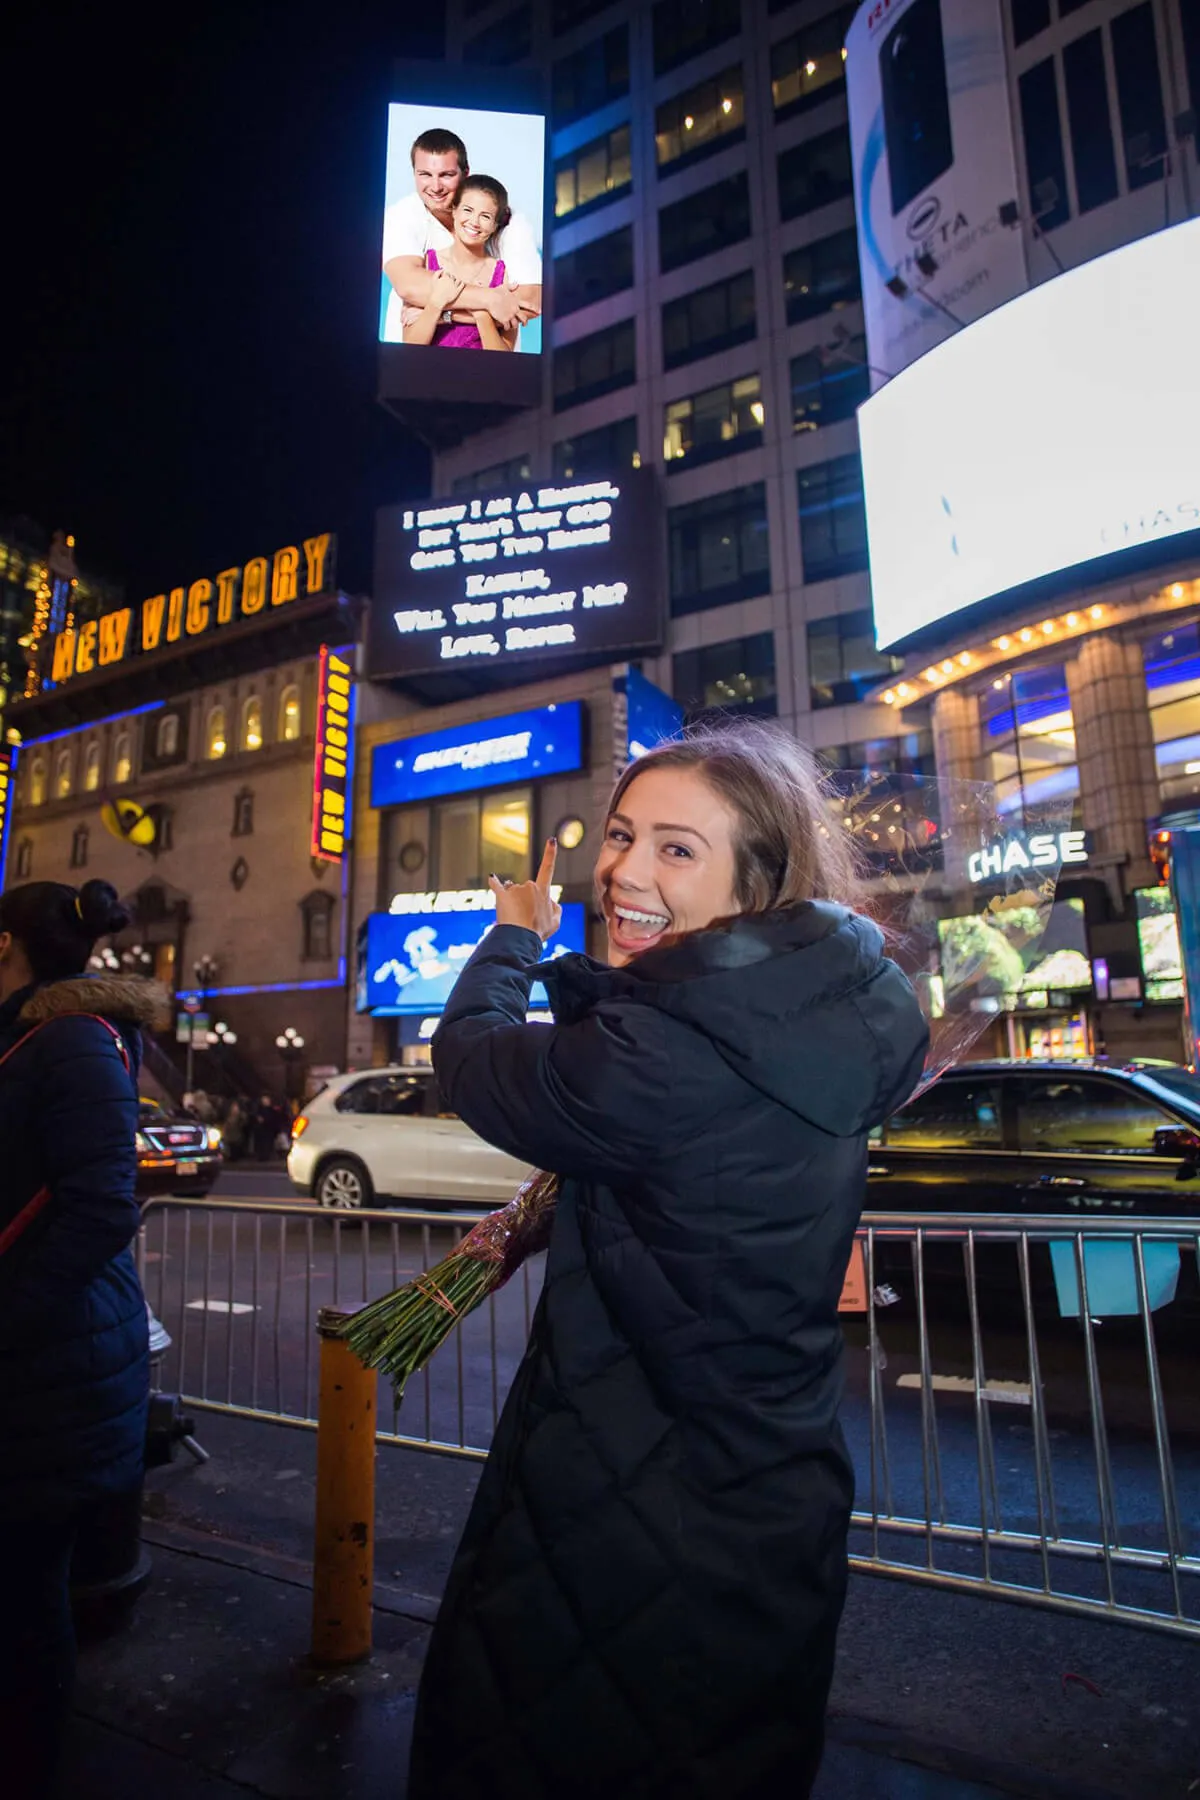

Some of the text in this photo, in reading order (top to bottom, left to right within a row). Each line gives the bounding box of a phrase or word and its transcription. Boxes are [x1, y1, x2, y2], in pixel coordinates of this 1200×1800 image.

[52, 533, 331, 681] NEW VICTORY
[324, 654, 351, 778] VICTORY
[968, 830, 1088, 882] CHASE
